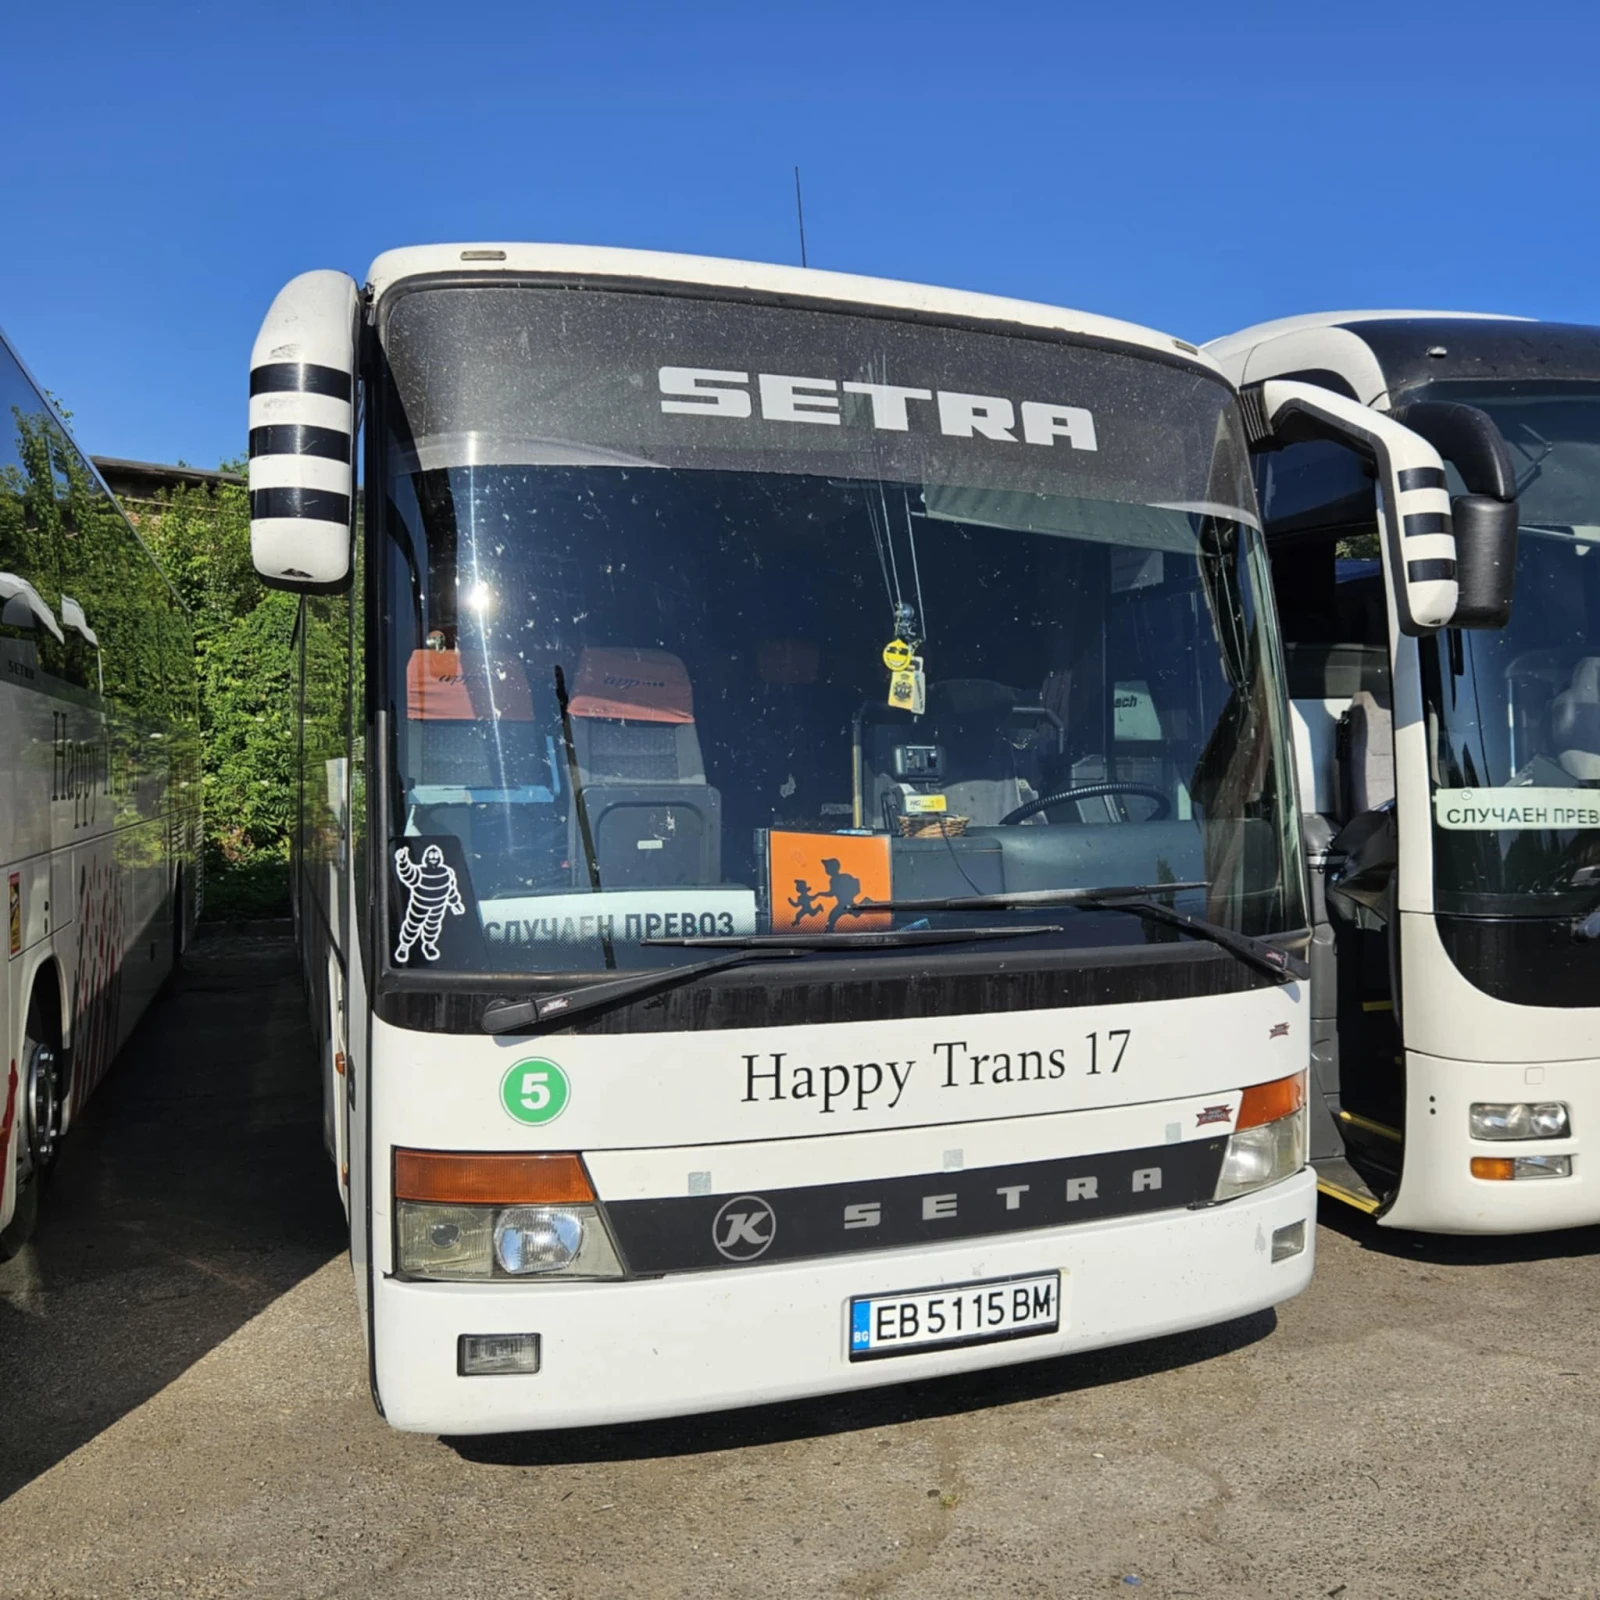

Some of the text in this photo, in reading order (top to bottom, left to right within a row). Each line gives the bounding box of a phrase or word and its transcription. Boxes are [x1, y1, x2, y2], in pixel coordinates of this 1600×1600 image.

[658, 366, 1098, 451] SETRA
[52, 711, 99, 829] Happy
[1447, 808, 1599, 824] СЛУЧАЕН ПРЕВ
[484, 911, 735, 943] СЛУЧАЕН ПРЕВОЗ
[520, 1072, 551, 1110] 5
[740, 1029, 1131, 1113] Happy Trans 17
[844, 1167, 1162, 1230] SETRA
[853, 1331, 869, 1342] BG
